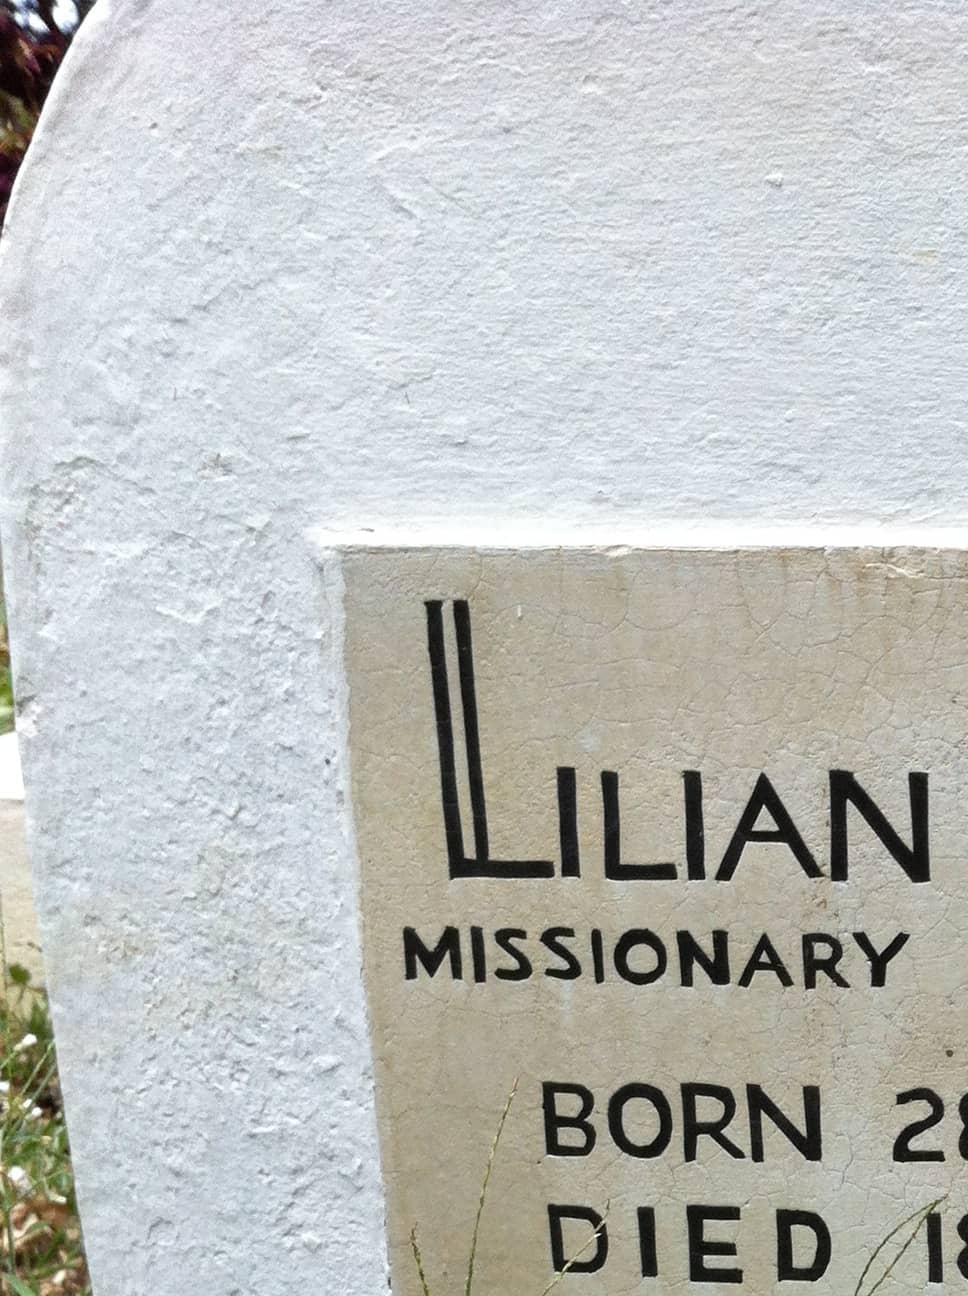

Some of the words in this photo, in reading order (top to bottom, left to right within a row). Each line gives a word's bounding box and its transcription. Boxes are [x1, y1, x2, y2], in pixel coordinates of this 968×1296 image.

[424, 600, 931, 884] LILIAN
[403, 925, 911, 989] MISSIONARY
[541, 1081, 823, 1163] BORN
[547, 1203, 832, 1284] DIED
